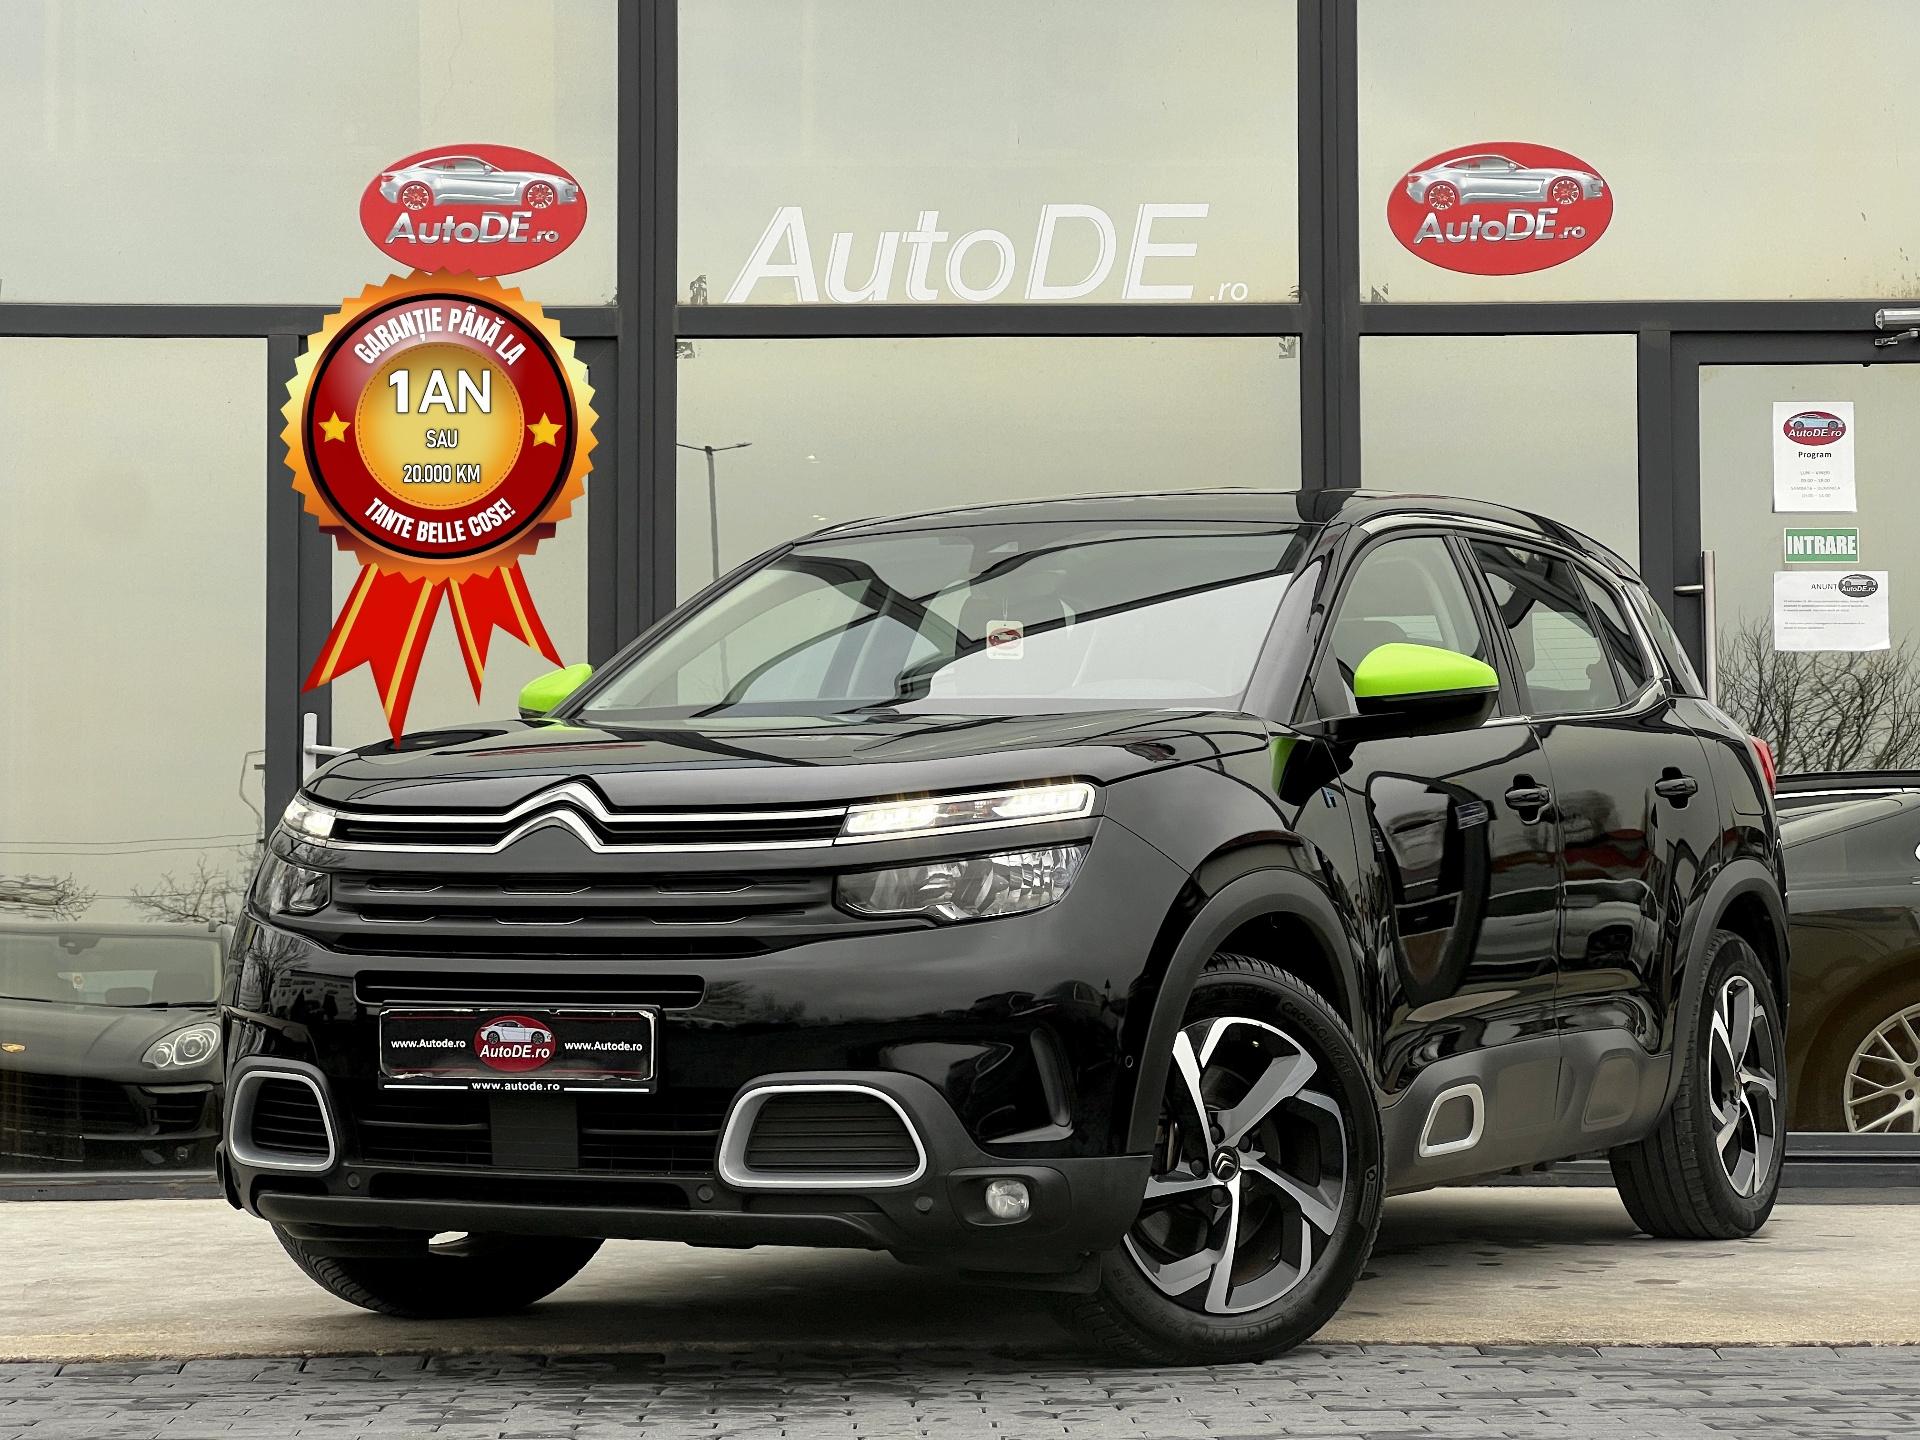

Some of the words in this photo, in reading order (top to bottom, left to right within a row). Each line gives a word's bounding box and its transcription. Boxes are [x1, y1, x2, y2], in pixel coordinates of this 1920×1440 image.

[1798, 451, 1832, 459] Program
[1787, 535, 1857, 555] INTRARE
[391, 1038, 466, 1049] www.Autode.ro
[564, 1040, 643, 1052] www.Autode.ro
[479, 1044, 550, 1059] AutoDE.ro
[472, 1081, 560, 1092] www.autode.ro
